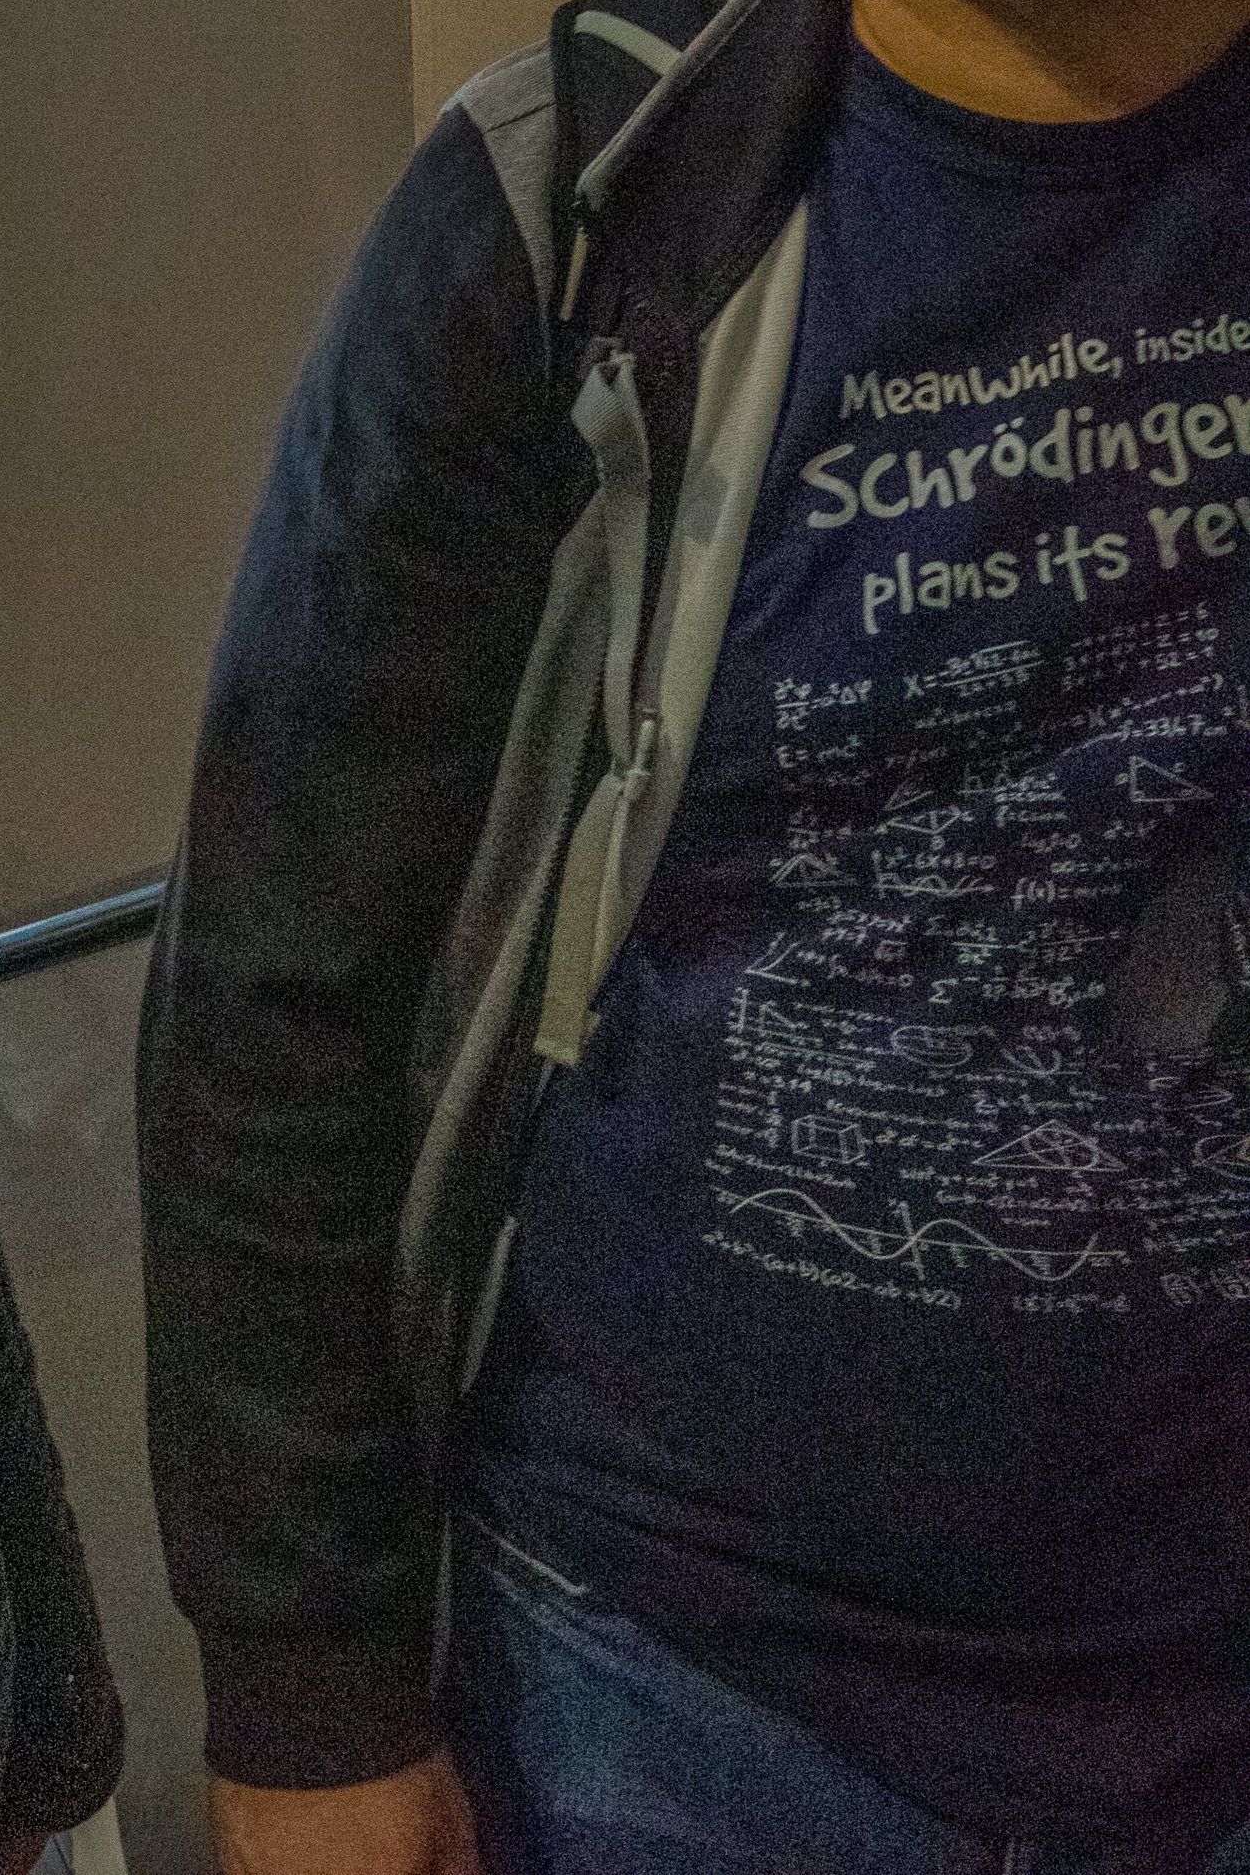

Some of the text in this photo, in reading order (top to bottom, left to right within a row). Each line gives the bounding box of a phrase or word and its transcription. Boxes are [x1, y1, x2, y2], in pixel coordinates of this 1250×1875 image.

[839, 313, 1250, 420] Meanwhile, inside
[861, 551, 1019, 636] plans
[1037, 525, 1131, 603] its
